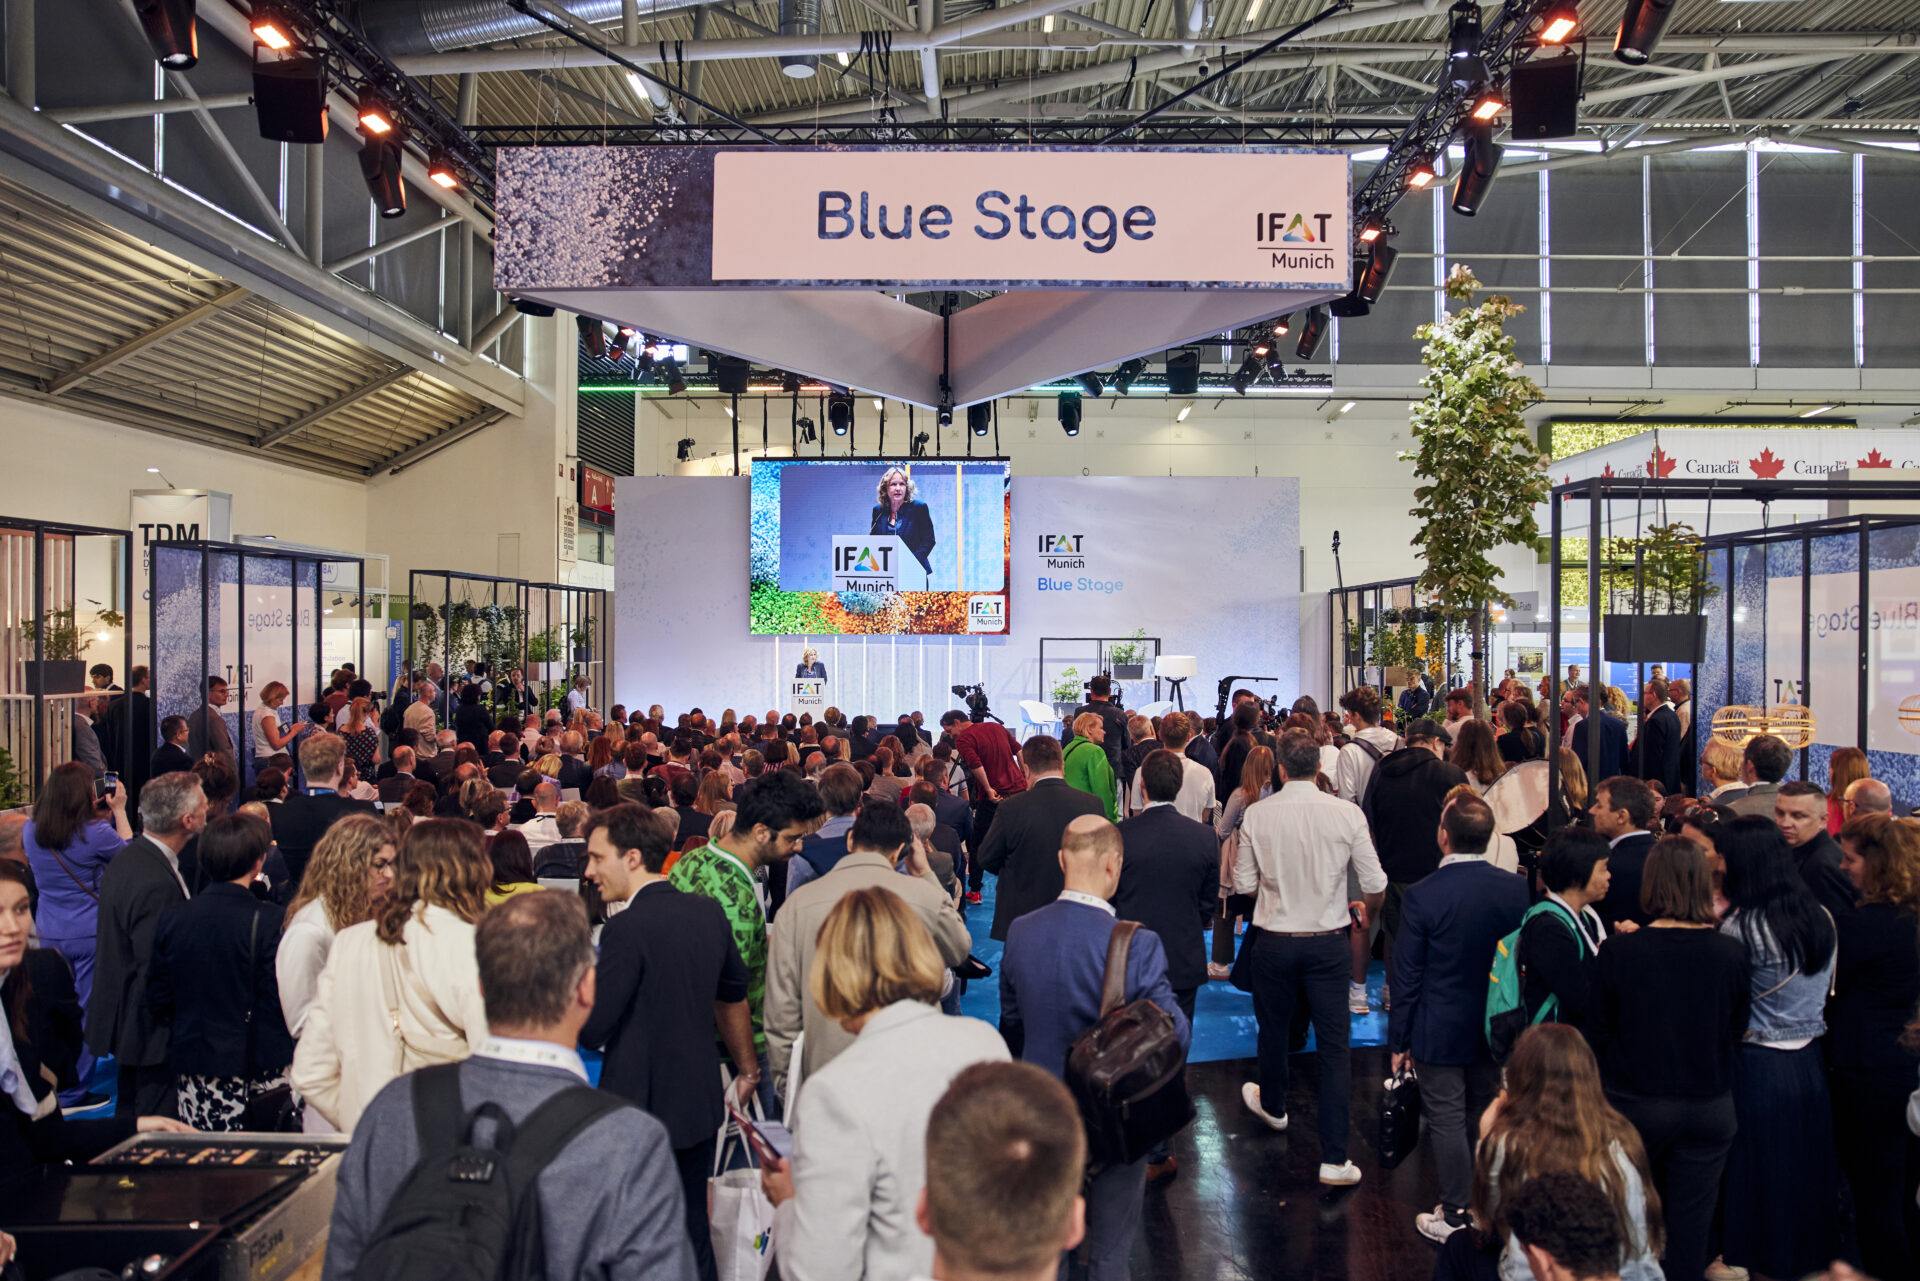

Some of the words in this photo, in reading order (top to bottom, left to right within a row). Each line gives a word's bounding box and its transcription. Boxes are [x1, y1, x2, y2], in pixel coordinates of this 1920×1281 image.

[817, 190, 953, 240] Blue
[974, 190, 1157, 254] Stage
[1257, 212, 1333, 243] IFAT
[1272, 252, 1335, 270] Munich
[1685, 459, 1740, 474] Canada
[138, 523, 200, 547] TDM
[1038, 534, 1084, 553] IFAT
[834, 546, 893, 572] IFAT
[1047, 558, 1085, 569] Munich
[1037, 577, 1073, 591] Blue
[1077, 577, 1124, 594] Stage
[971, 602, 1002, 615] IFAT
[977, 617, 1003, 626] Munich
[792, 683, 821, 695] IFAT
[798, 697, 822, 705] Munich
